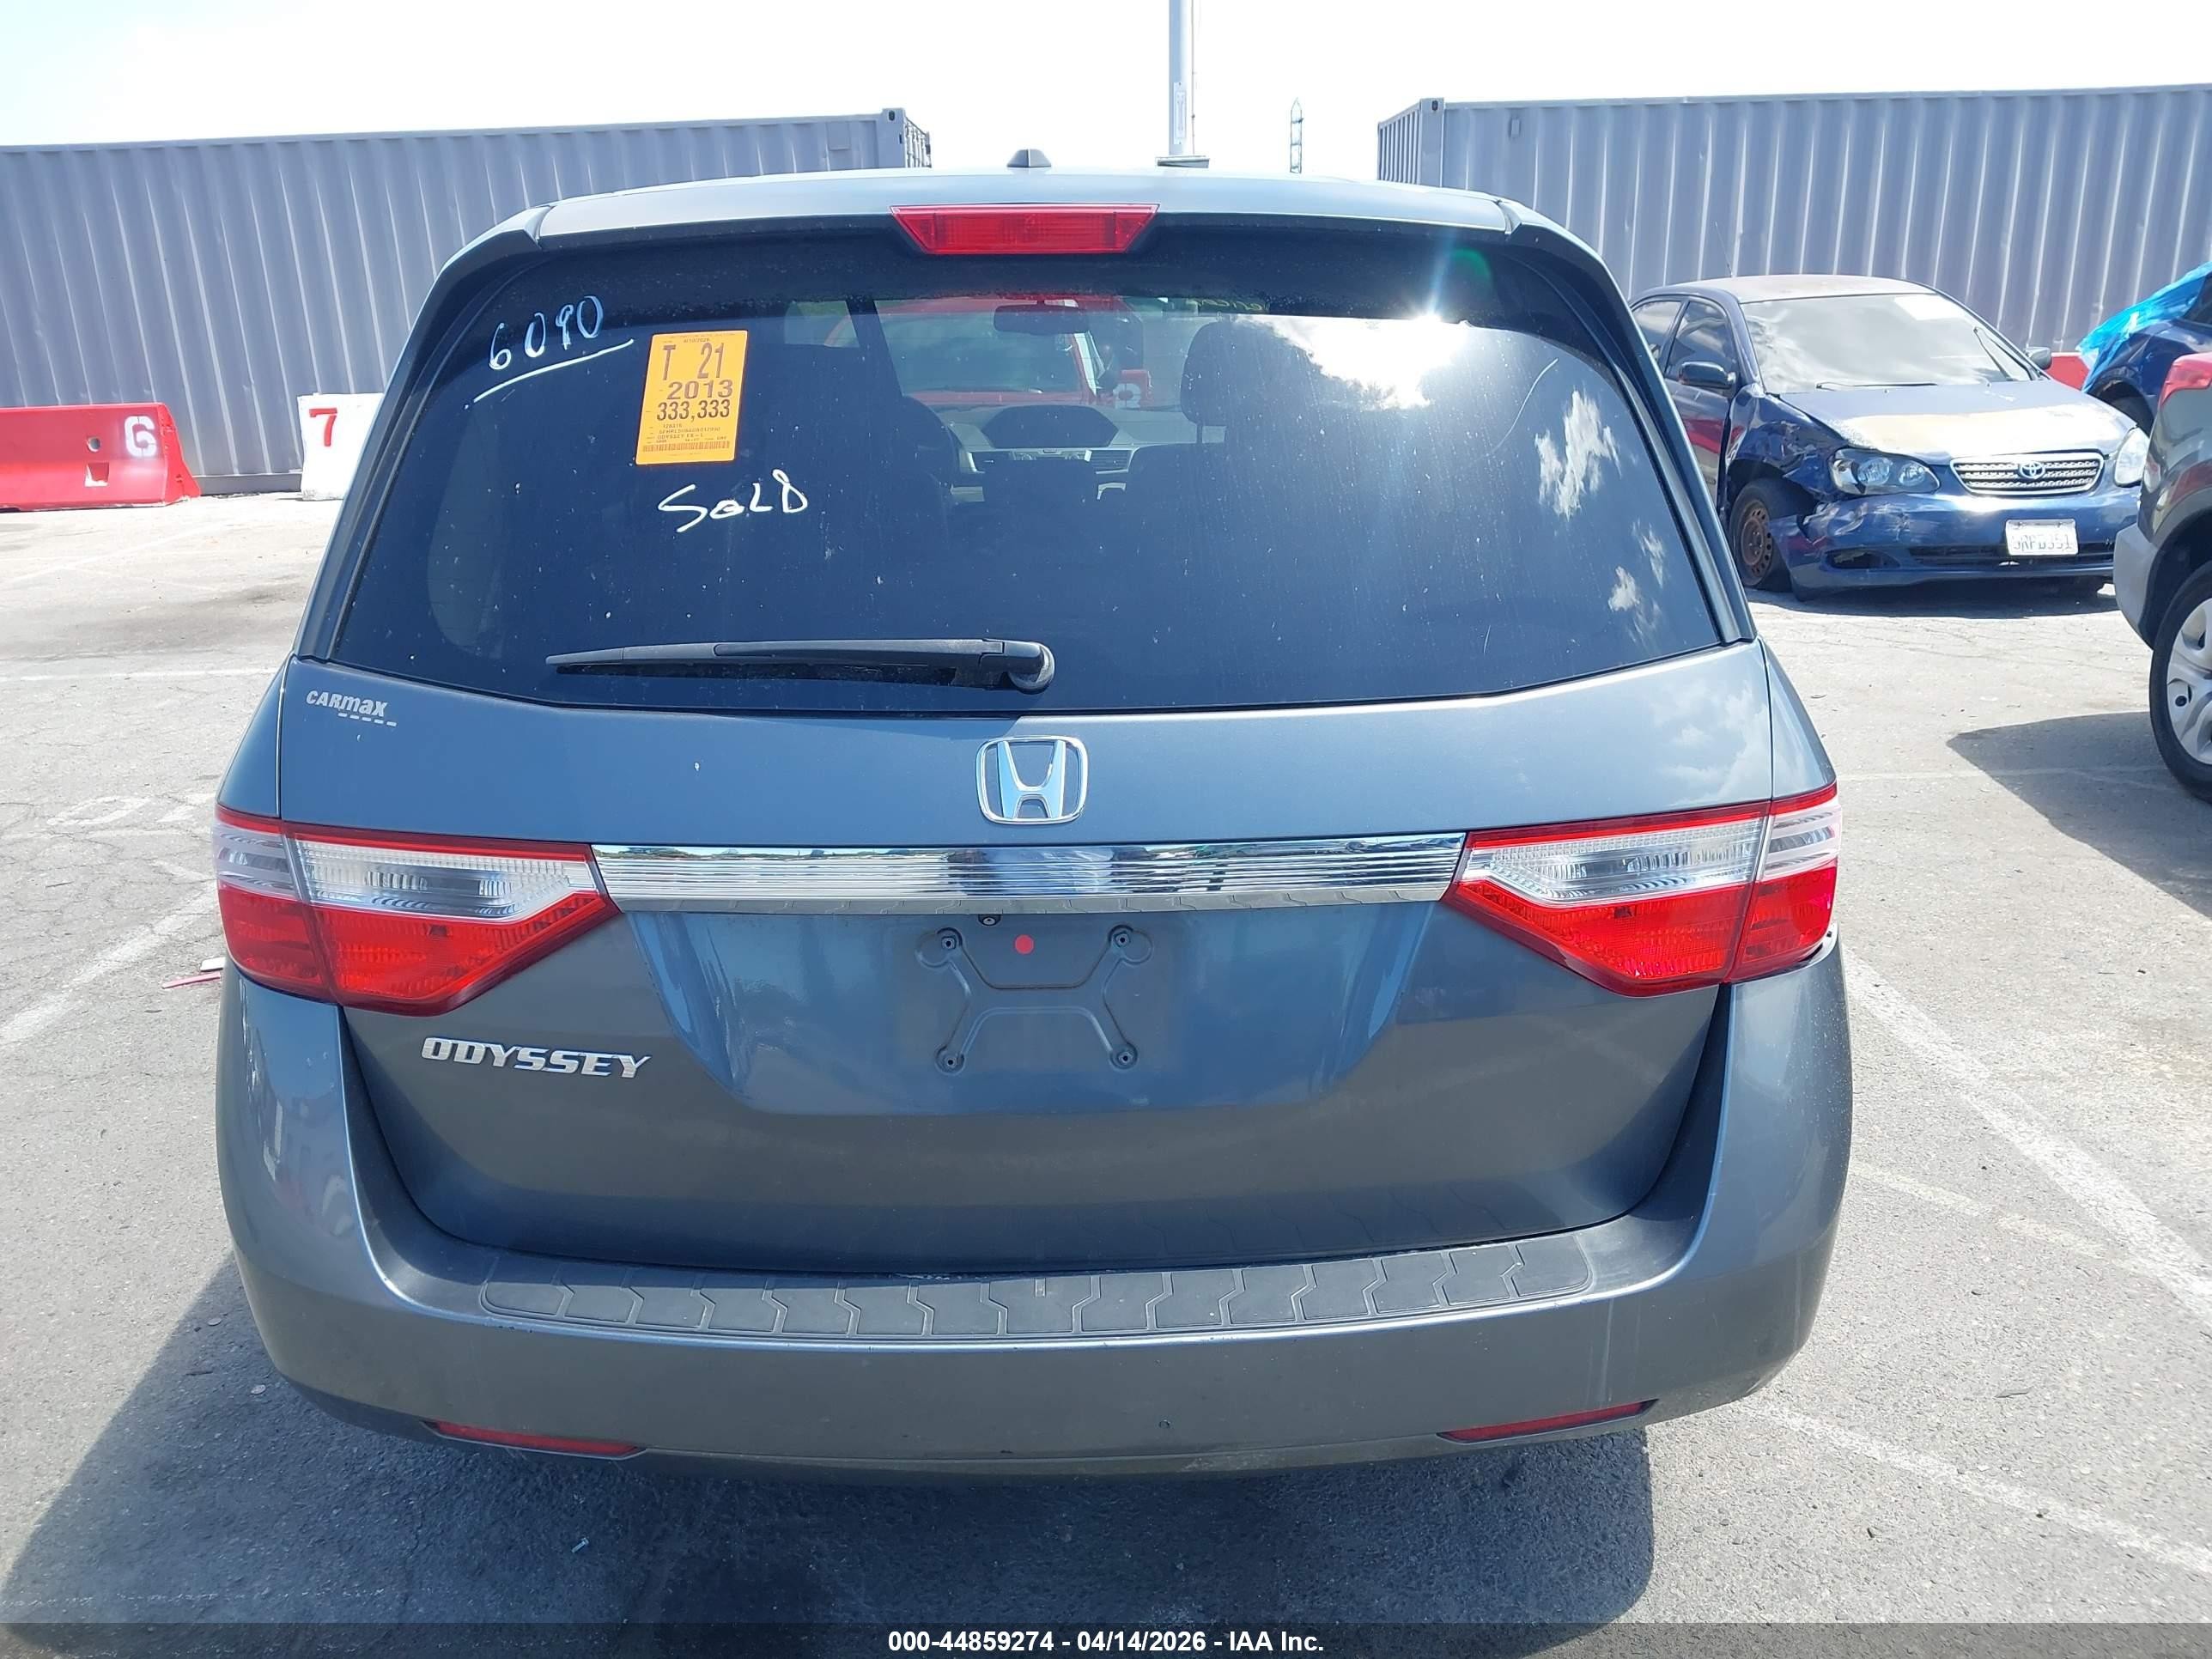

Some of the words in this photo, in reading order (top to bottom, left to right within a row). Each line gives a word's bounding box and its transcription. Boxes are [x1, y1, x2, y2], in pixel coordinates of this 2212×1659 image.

[489, 295, 604, 371] 6090
[662, 344, 677, 380] T
[697, 342, 725, 380] 21
[666, 380, 733, 400] 2013
[308, 408, 338, 447] 7
[657, 399, 731, 422] 333,333
[125, 416, 156, 458] 6
[421, 1036, 653, 1079] ODYSSEY
